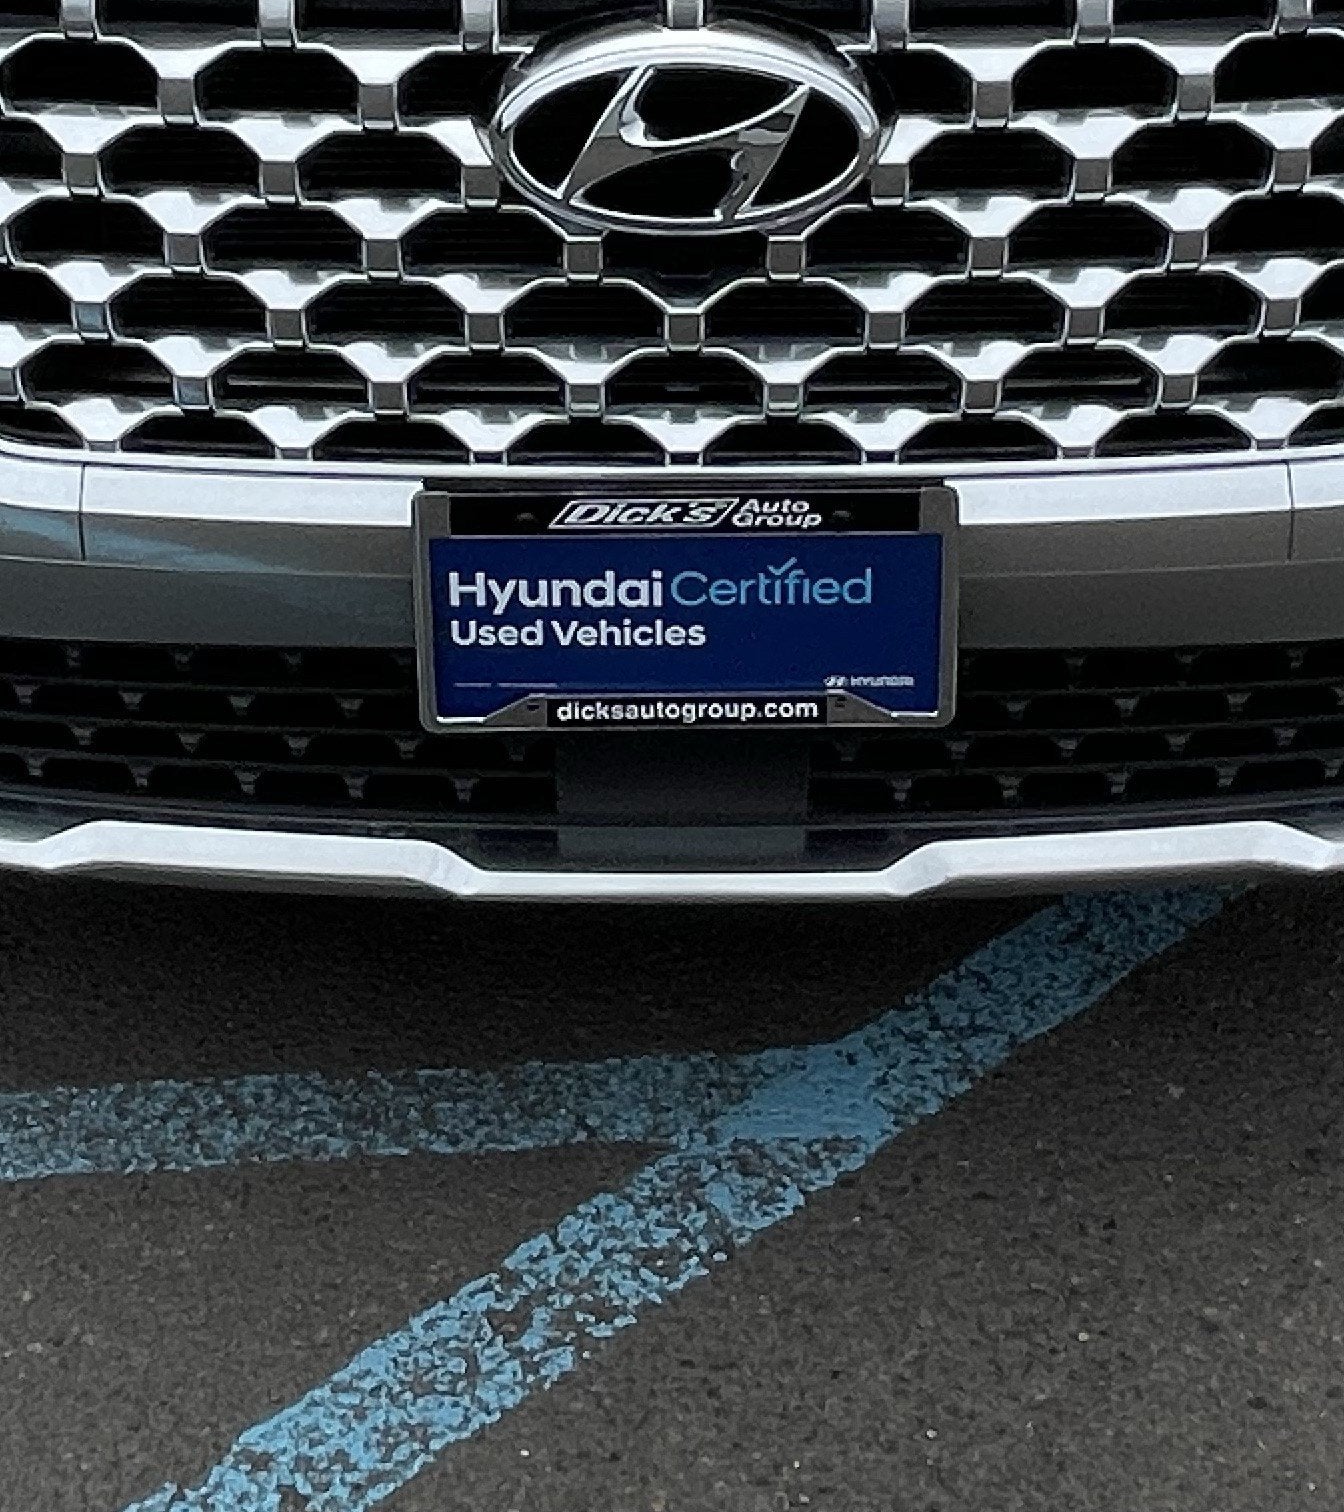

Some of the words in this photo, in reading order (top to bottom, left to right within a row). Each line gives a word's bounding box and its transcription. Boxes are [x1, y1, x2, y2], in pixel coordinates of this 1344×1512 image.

[739, 499, 810, 514] Auto
[732, 512, 822, 529] Group
[448, 569, 663, 616] Hyundai
[671, 560, 873, 606] Certified
[450, 620, 545, 647] Used
[550, 618, 707, 648] Vehicles
[556, 696, 820, 723] dicksautogroup.com
